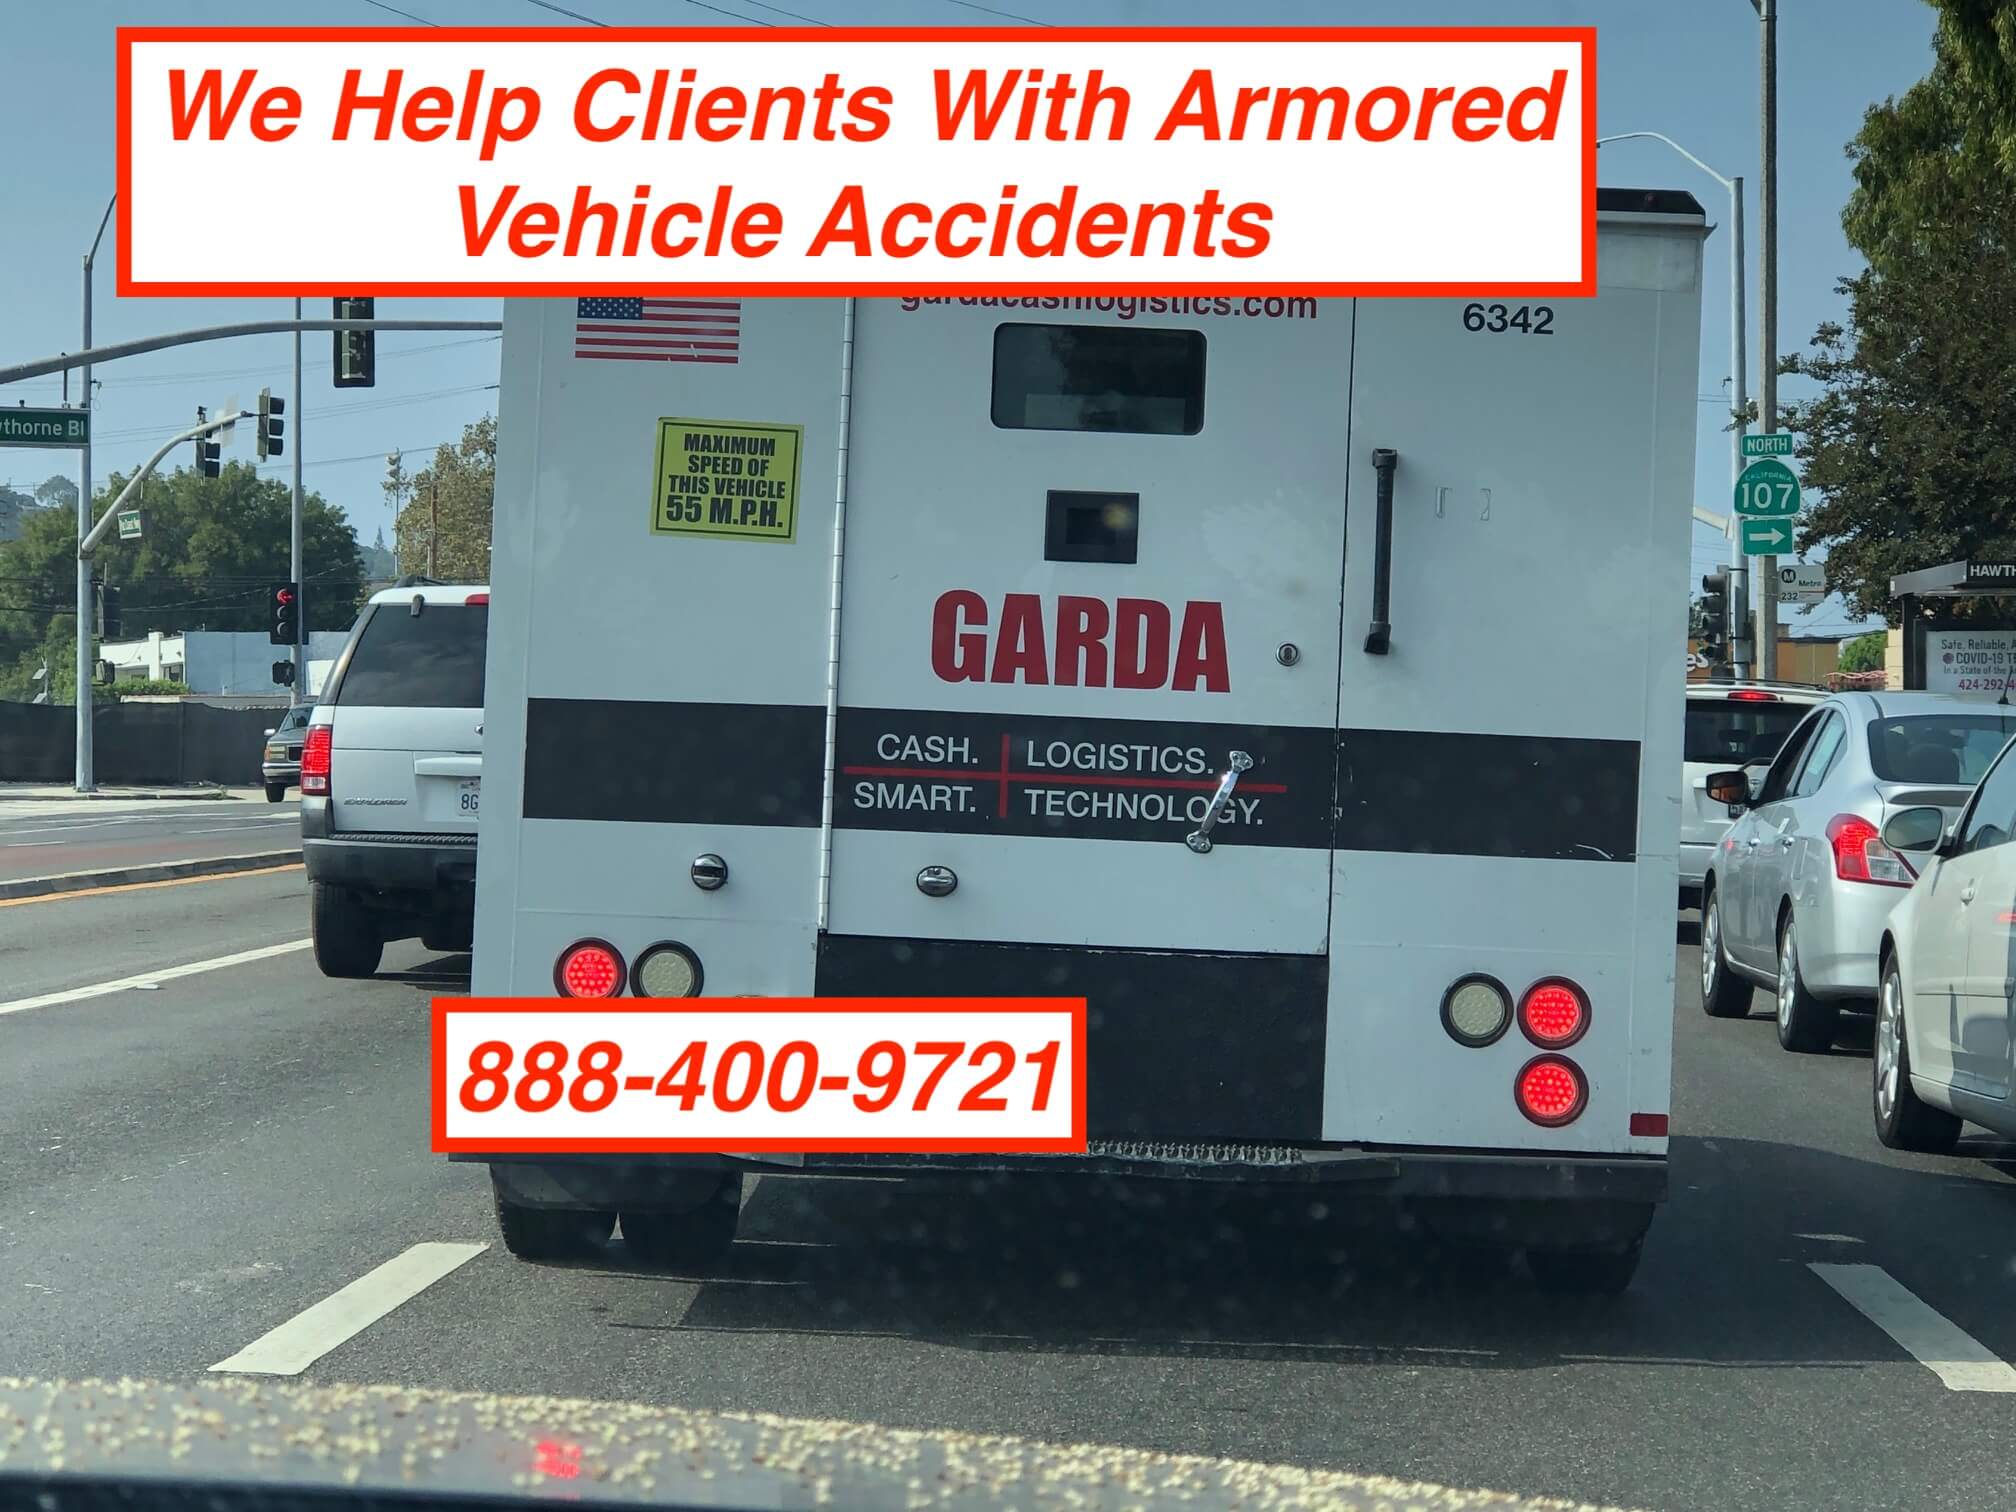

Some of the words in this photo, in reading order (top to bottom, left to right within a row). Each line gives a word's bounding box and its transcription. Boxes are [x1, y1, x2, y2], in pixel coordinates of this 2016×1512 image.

[1463, 303, 1554, 335] 6342
[68, 420, 84, 437] Bl
[684, 433, 776, 457] MAXIMUM
[1747, 438, 1788, 452] NORTH
[688, 455, 743, 476] SPEED
[747, 458, 770, 477] OF
[668, 475, 710, 495] THIS
[714, 478, 786, 499] VEHICLE
[1742, 483, 1793, 509] 107
[666, 495, 702, 523] 55
[709, 497, 784, 528] M.P.H.
[1798, 579, 1823, 587] Metro
[1781, 592, 1798, 601] 232
[931, 589, 1231, 693] GARDA
[1956, 652, 2004, 665] COVID-19
[877, 734, 979, 764] CASH.
[1027, 740, 1214, 775] LOGISTICS.
[854, 782, 976, 813] SMART.
[1024, 789, 1263, 825] TECHNOLOGY.
